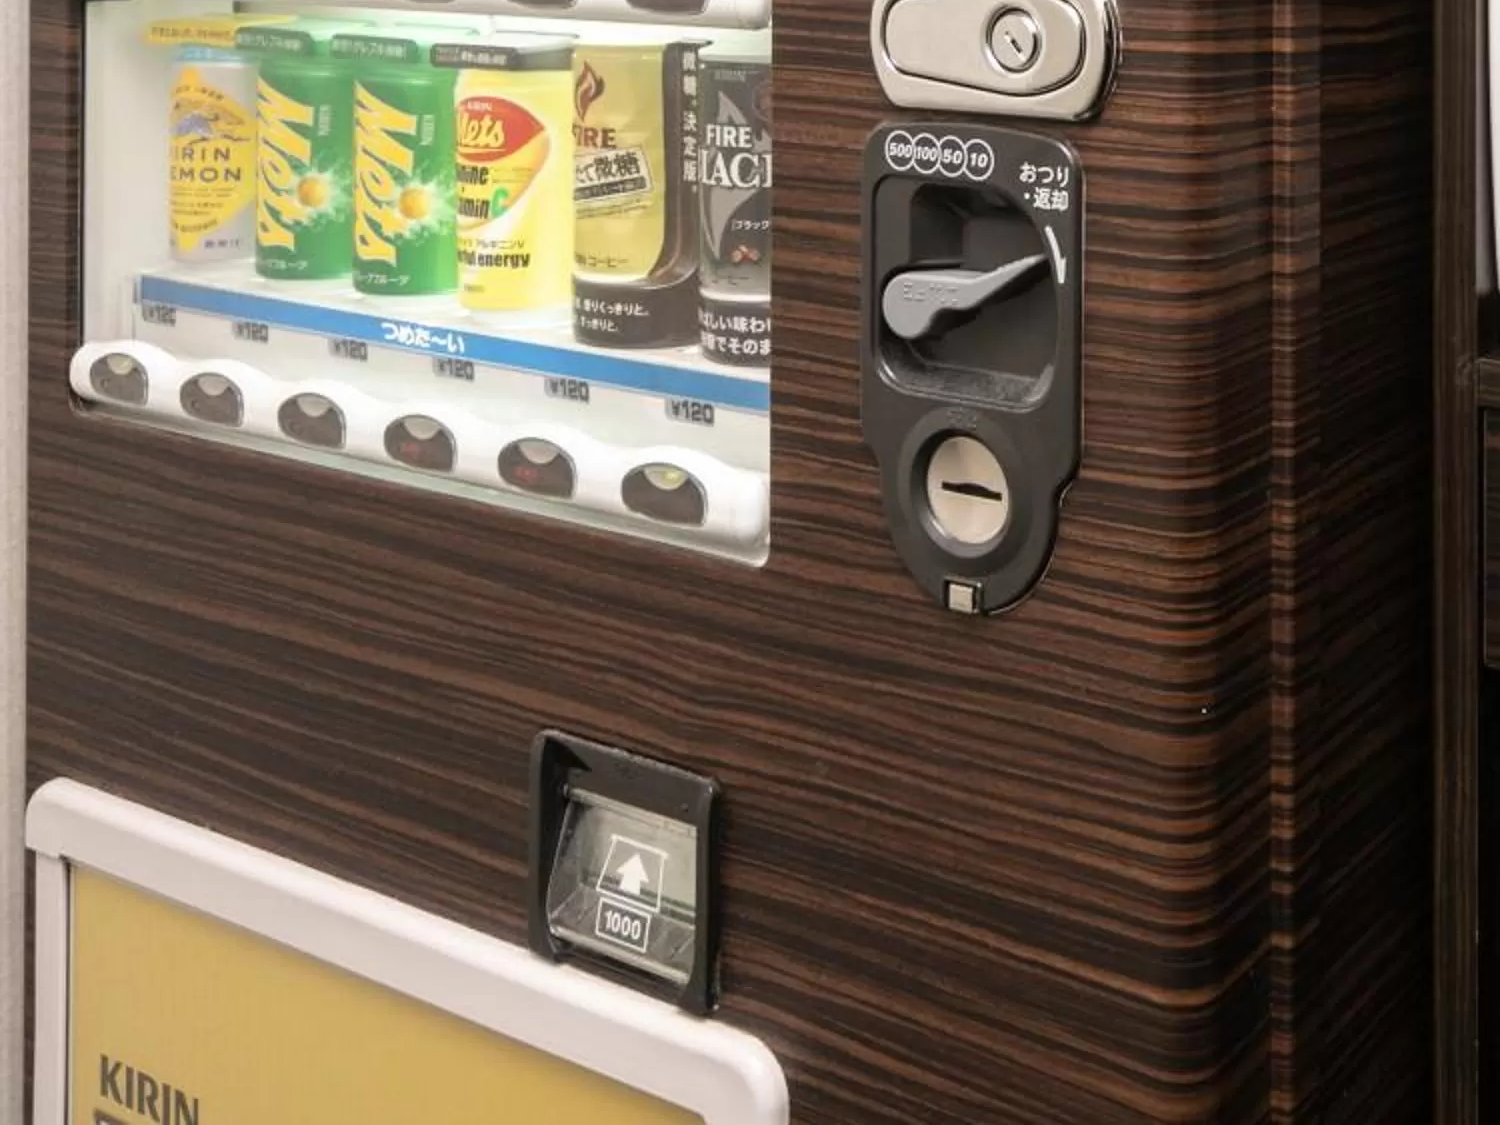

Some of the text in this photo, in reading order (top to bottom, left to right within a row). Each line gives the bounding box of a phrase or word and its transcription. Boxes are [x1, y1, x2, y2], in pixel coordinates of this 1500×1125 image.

[705, 123, 753, 148] FIRE
[888, 142, 988, 168] 500 100 50 10
[353, 80, 419, 267] Mets
[699, 149, 773, 189] LAC
[1019, 161, 1070, 187] おつり
[549, 378, 590, 403] ¥120
[671, 398, 715, 425] ¥120
[604, 909, 642, 942] 1000
[100, 1053, 199, 1125] KIRIN
